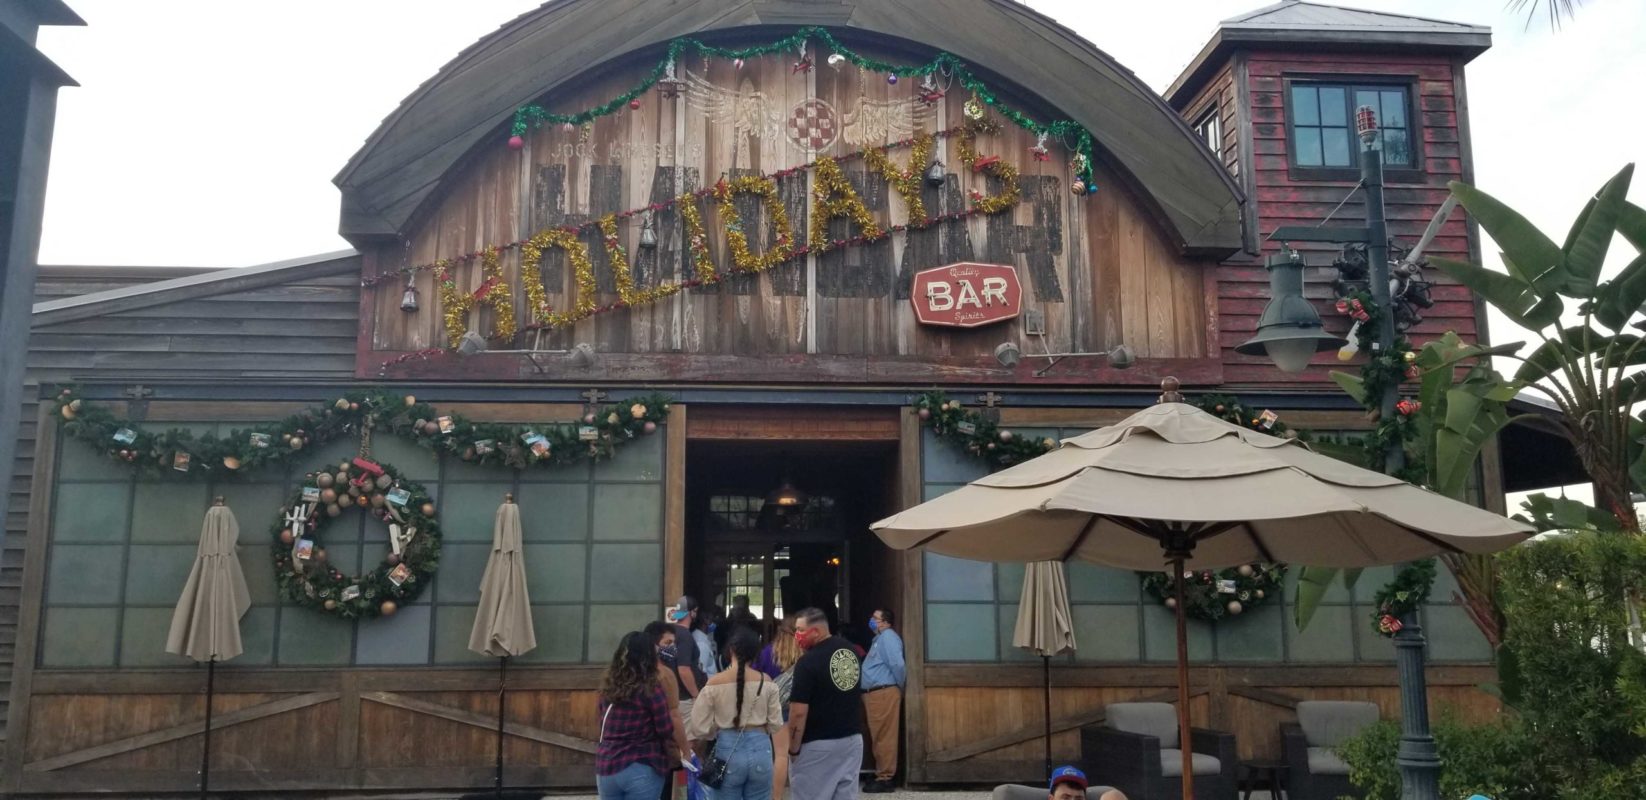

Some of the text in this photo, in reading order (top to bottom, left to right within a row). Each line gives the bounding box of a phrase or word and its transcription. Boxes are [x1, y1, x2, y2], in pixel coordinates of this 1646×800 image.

[551, 142, 599, 159] JOCK
[433, 119, 1020, 349] HOLIDAYS
[949, 267, 981, 278] Quality
[927, 277, 1010, 312] BAR
[954, 311, 986, 322] Spirits
